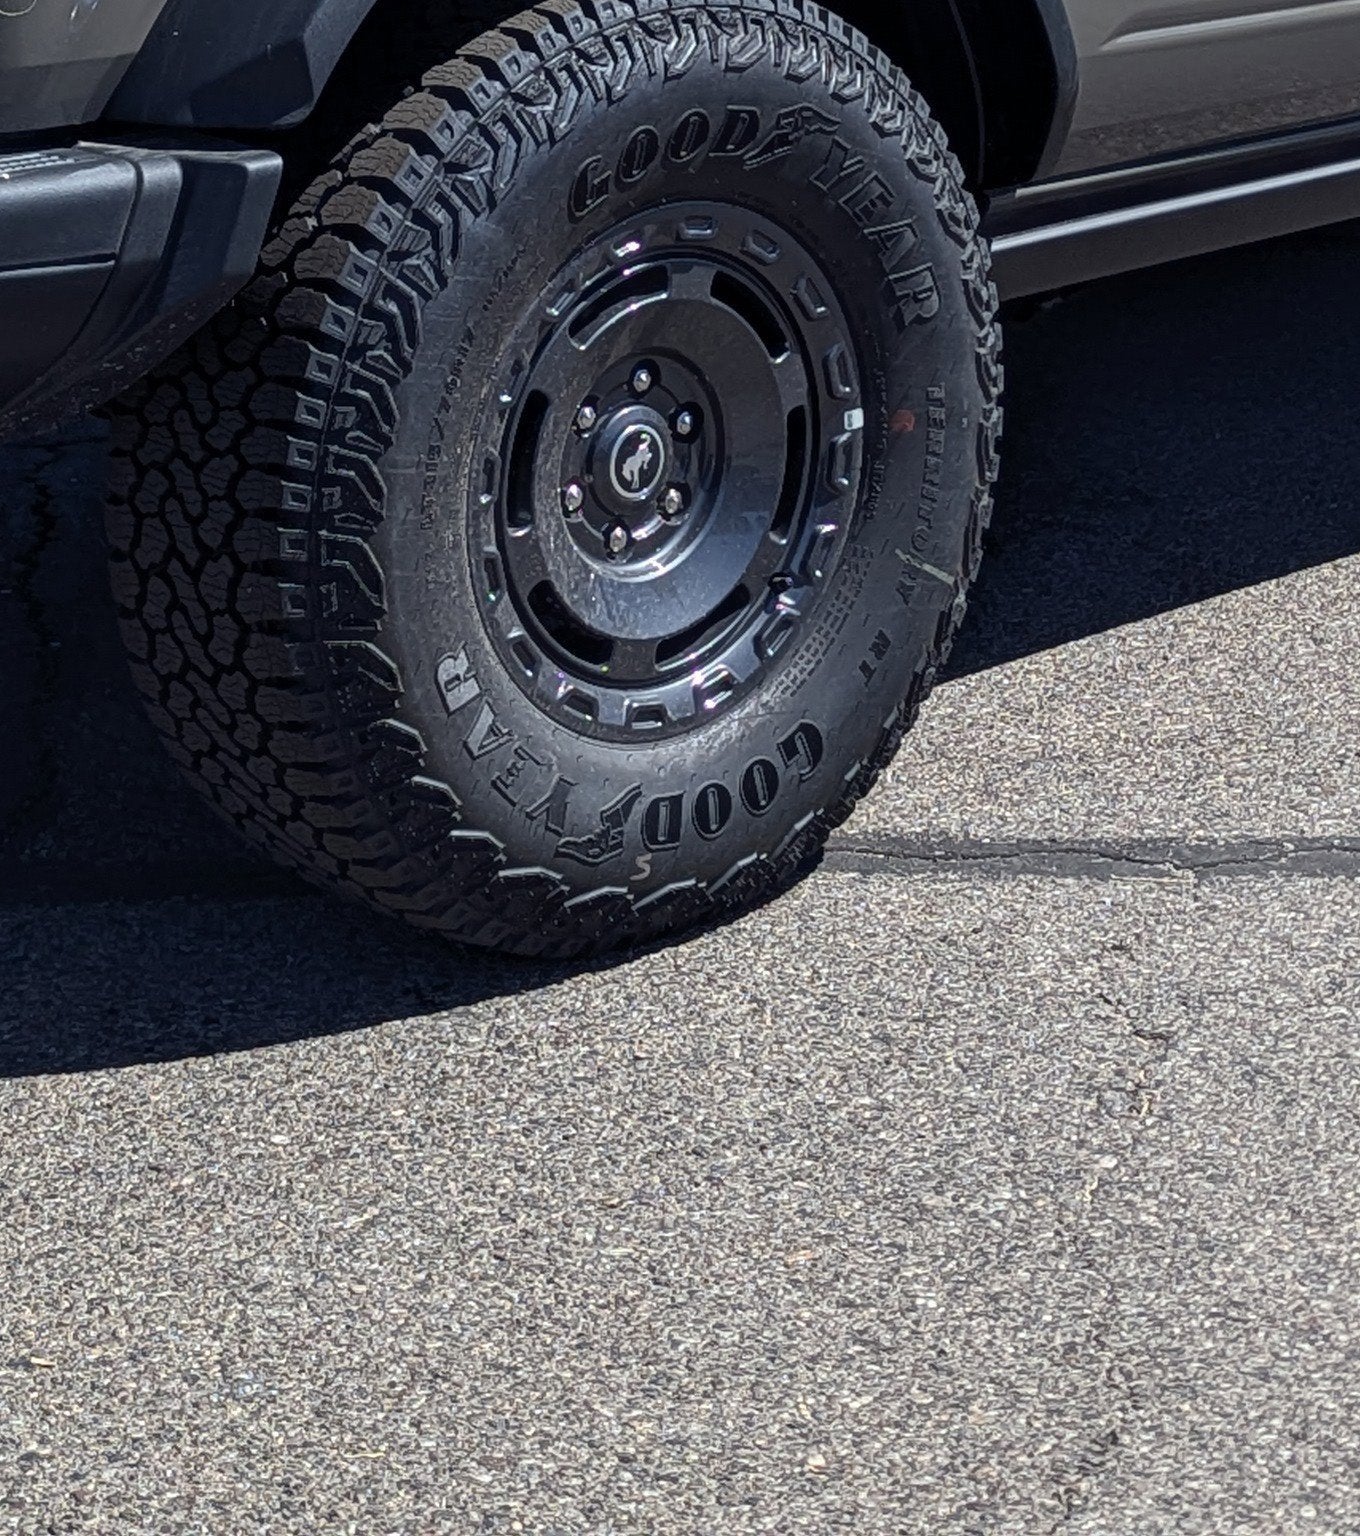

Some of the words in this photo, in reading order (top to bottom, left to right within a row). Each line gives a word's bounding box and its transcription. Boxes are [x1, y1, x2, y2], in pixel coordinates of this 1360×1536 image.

[566, 104, 945, 334] GOODYEAR
[434, 640, 827, 867] GOODYEAR
[858, 627, 893, 688] RT
